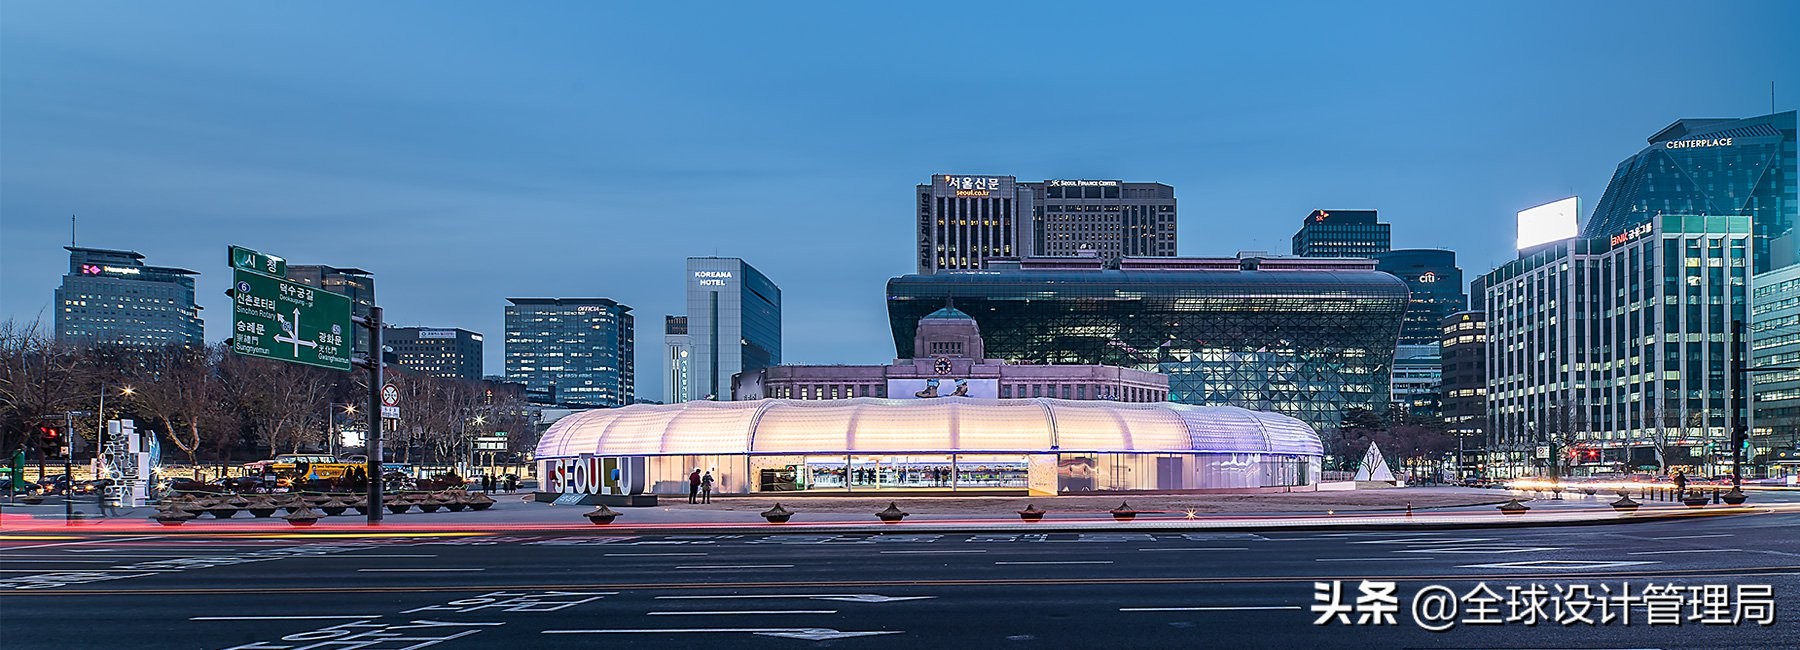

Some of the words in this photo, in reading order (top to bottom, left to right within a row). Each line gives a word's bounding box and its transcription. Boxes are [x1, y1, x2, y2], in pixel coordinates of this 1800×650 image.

[1666, 138, 1732, 149] CENTERPLACE
[948, 177, 999, 190] 서울신문
[1611, 232, 1629, 247] BNK
[1419, 272, 1435, 283] citi
[280, 283, 313, 301] 덕수궁길
[237, 293, 275, 311] 신촌로터리
[237, 305, 258, 316] Sinchon
[259, 309, 276, 321] Rotary
[236, 320, 266, 335] 숭례문
[554, 458, 612, 495] SEOUL
